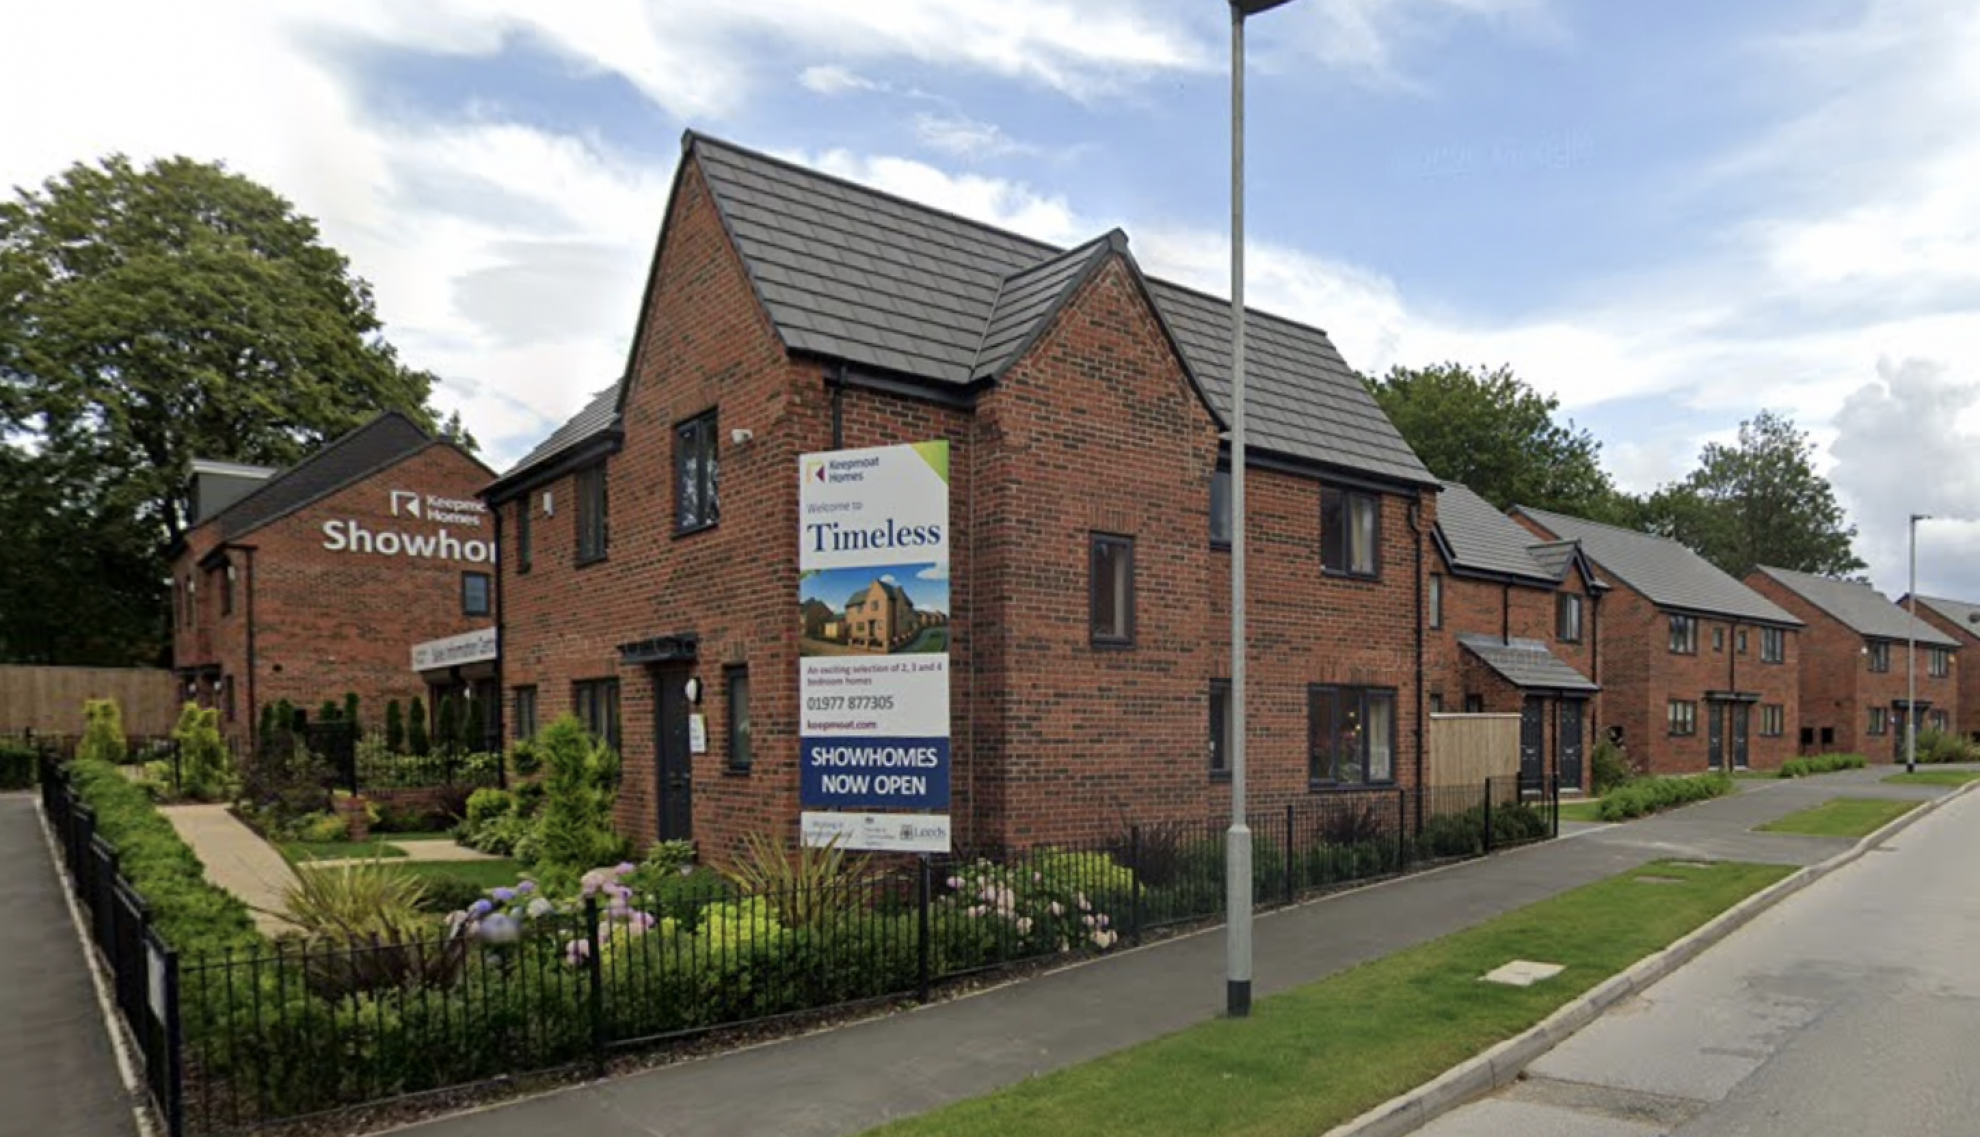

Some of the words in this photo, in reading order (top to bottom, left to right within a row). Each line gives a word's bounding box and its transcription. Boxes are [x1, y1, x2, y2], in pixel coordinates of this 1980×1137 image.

[829, 457, 879, 470] Keepmoat
[829, 472, 864, 483] Homes
[808, 503, 850, 513] Welcome
[852, 502, 863, 511] to
[427, 509, 480, 526] Homes
[807, 519, 941, 552] Timeless
[807, 697, 844, 710] 01977
[848, 696, 894, 710] 877305
[807, 719, 877, 731] keepmoat.com
[811, 747, 938, 768] SHOWHOMES
[821, 775, 870, 794] NOW
[874, 775, 926, 795] OPEN
